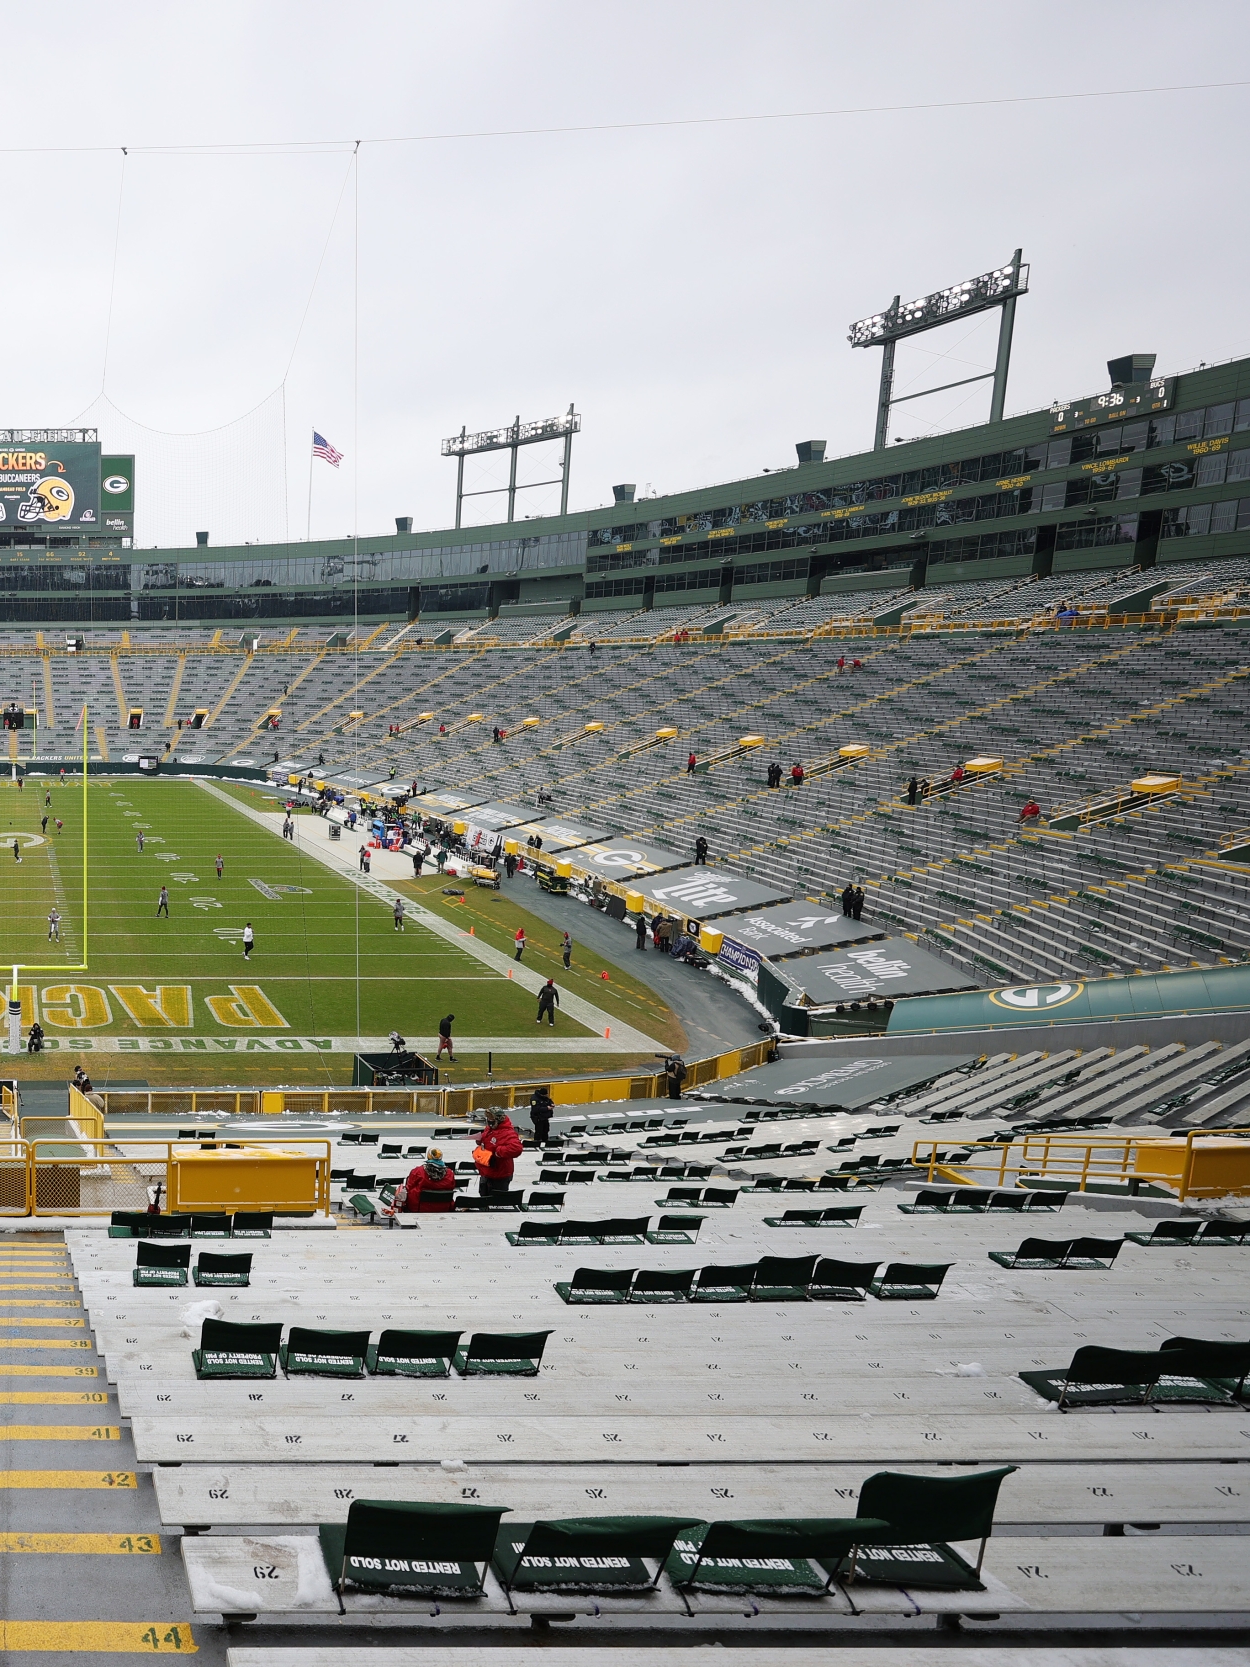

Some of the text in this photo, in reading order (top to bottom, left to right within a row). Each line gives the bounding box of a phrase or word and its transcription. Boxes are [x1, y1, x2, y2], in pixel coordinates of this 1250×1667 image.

[1150, 380, 1165, 389] BUCS
[1158, 387, 1165, 398] 0
[1098, 393, 1124, 408] 9:36
[1050, 404, 1071, 414] PACKERS
[1057, 412, 1064, 422] 0
[30, 430, 76, 441] FIELD
[1187, 437, 1229, 451] WILLIE DAVIS
[1193, 444, 1221, 455] 1960-69
[1081, 456, 1129, 471] VINCE LOMBARDI
[1091, 464, 1116, 474] 1959-67
[106, 518, 125, 526] bellin
[113, 524, 128, 532] health
[651, 881, 738, 909] Lite
[737, 926, 773, 941] Bank
[744, 916, 813, 944] Associated
[847, 949, 912, 979] bellin
[816, 961, 885, 994] health
[117, 1039, 333, 1053] ADVANCE
[64, 1319, 80, 1327] 37
[69, 1339, 88, 1349] 38
[74, 1366, 95, 1377] 39
[80, 1392, 103, 1404] 40
[90, 1427, 110, 1440] 41
[176, 1434, 197, 1442] 29
[100, 1472, 130, 1487] 42
[208, 1489, 232, 1499] 29
[460, 1487, 482, 1499] 27
[710, 1488, 737, 1498] 25
[118, 1536, 153, 1553] 43
[673, 1539, 699, 1551] PMI
[555, 1556, 580, 1568] NOT
[867, 1549, 945, 1563] RENTED NOT
[350, 1556, 462, 1575] RENTED NOT SOLD
[580, 1556, 631, 1569] RENTED
[717, 1557, 795, 1571] RENTED NOT
[253, 1564, 283, 1579] 29
[140, 1626, 183, 1650] 44
